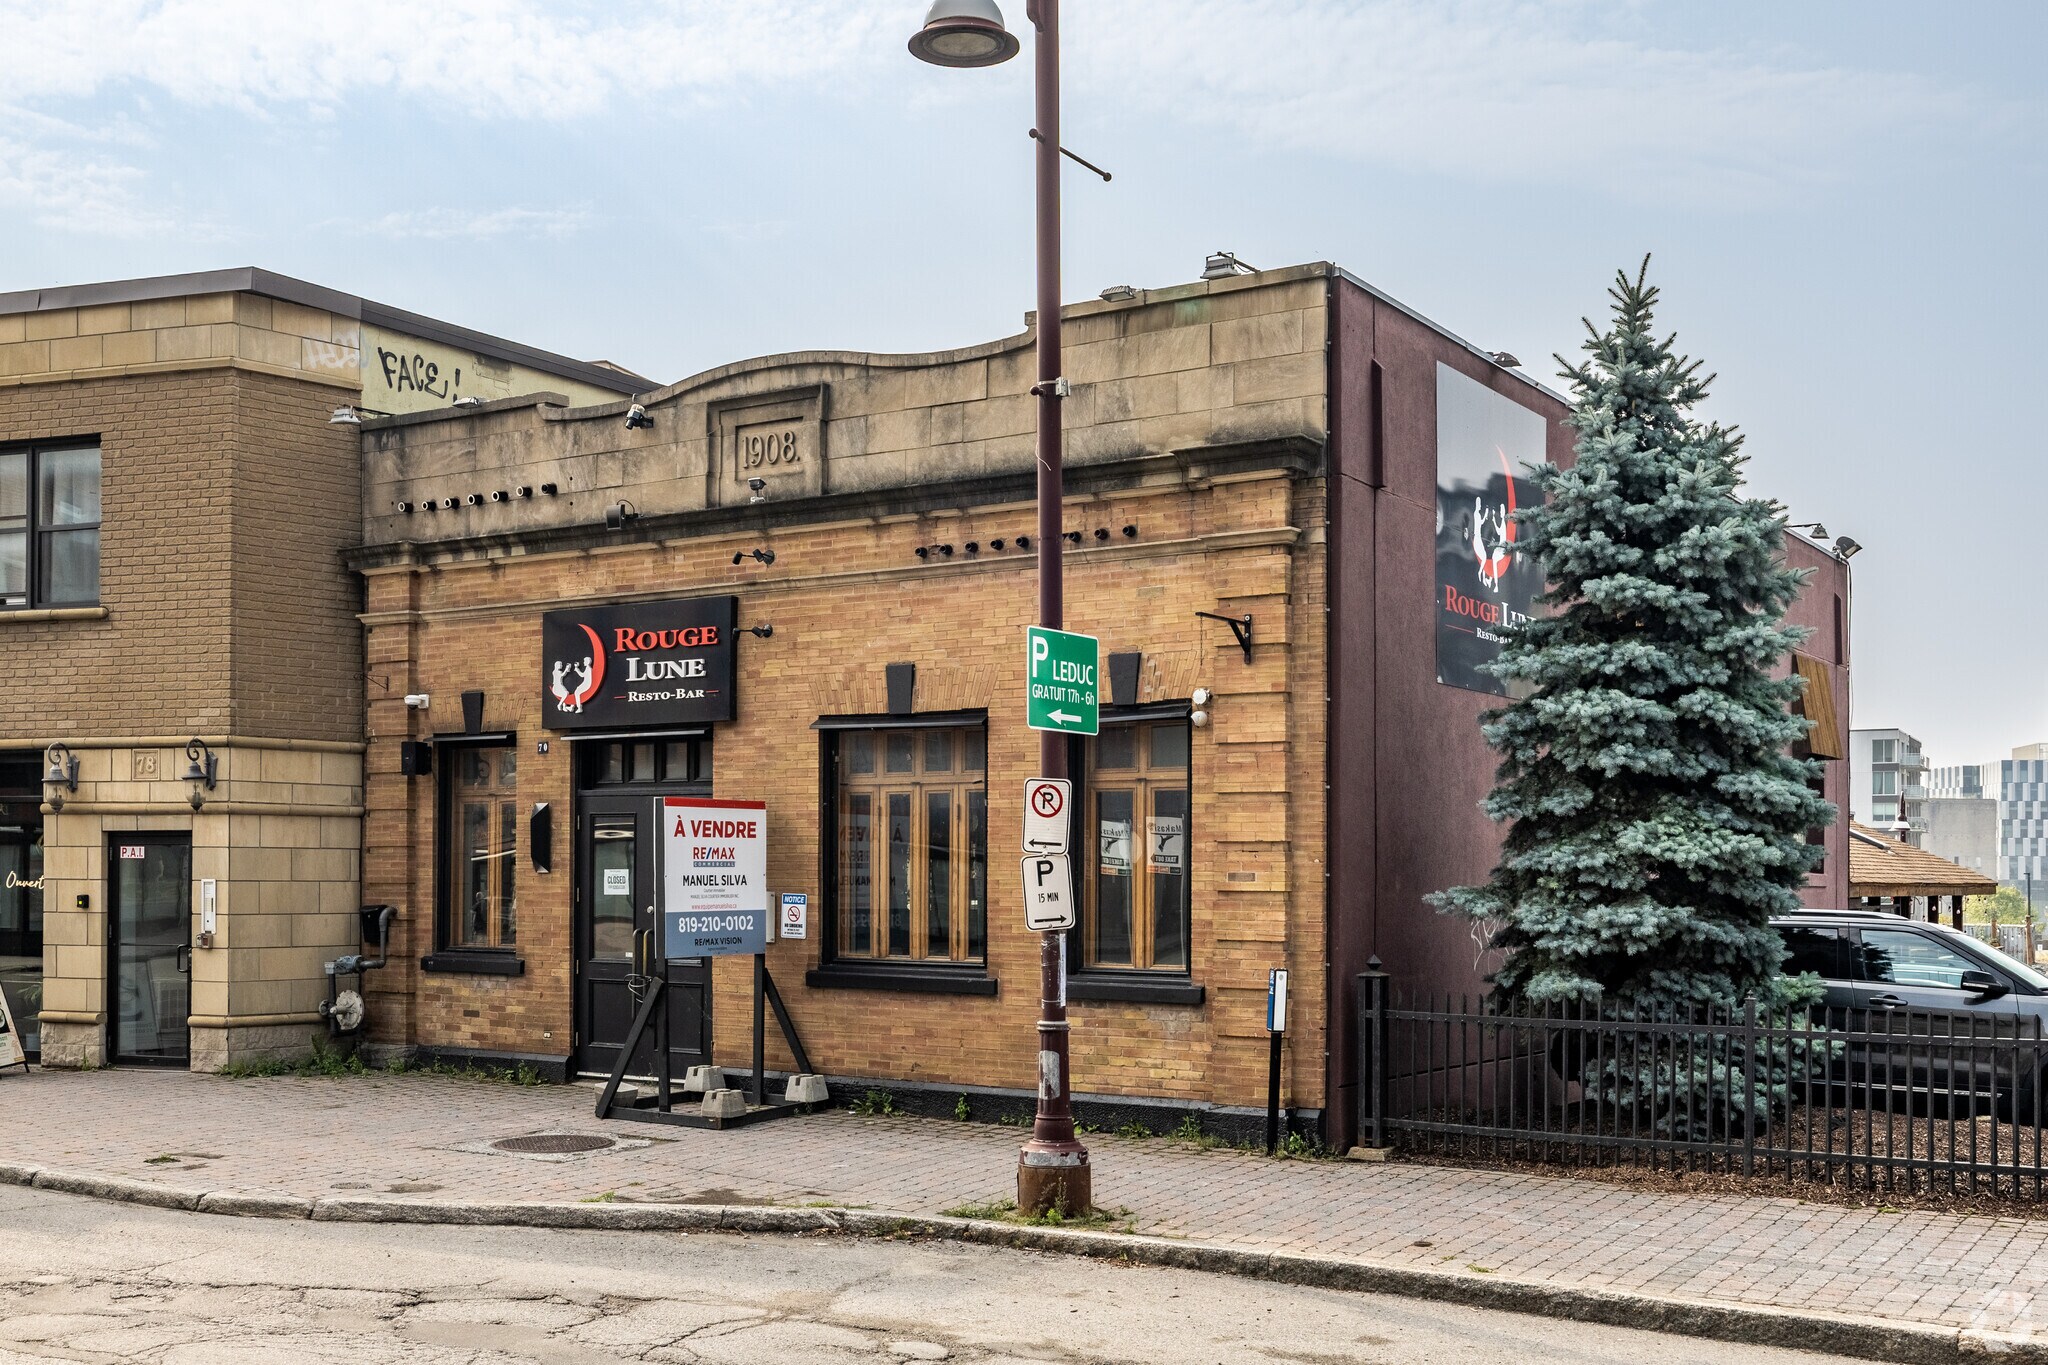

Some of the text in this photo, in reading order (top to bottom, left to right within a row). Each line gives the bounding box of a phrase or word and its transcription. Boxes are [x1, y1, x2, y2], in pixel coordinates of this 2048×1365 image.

[1445, 584, 1500, 624] ROUGE
[614, 626, 718, 652] ROUGE
[625, 657, 707, 681] LUNE
[1032, 635, 1094, 686] P LEDUC
[628, 688, 705, 702] RESTO-BAR
[1032, 683, 1066, 702] GRATUIT
[1067, 688, 1080, 704] 17h
[1085, 691, 1095, 706] 6h
[538, 743, 548, 751] 70
[136, 757, 156, 774] 78
[674, 815, 757, 839] À VENDRE
[693, 847, 735, 860] RE/MAX
[607, 875, 626, 885] CLOSED
[683, 875, 747, 887] MANUEL SILVA
[1036, 859, 1054, 887] P
[784, 896, 805, 904] NOTICE
[1038, 891, 1059, 903] 15 MIN
[678, 915, 754, 933] 819-210-0102
[694, 936, 743, 947] RE/MAX VISION
